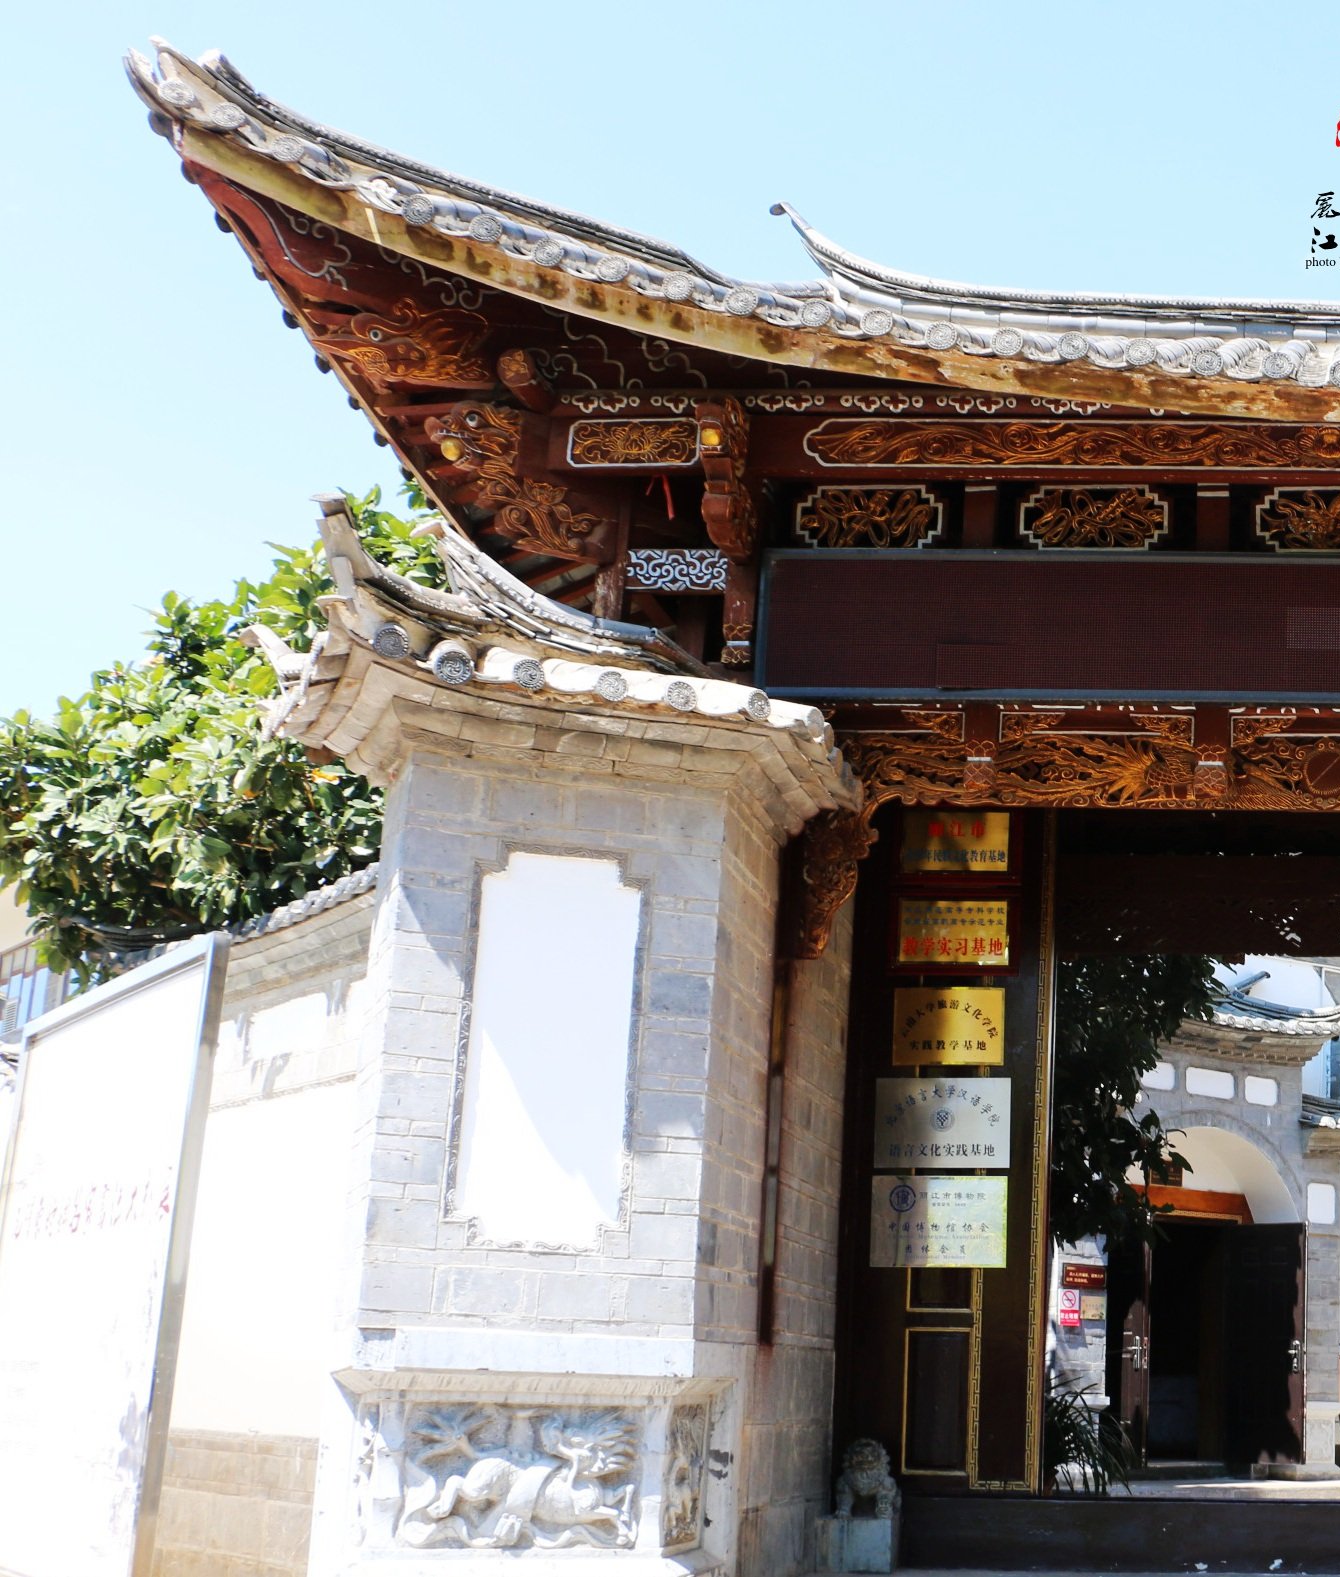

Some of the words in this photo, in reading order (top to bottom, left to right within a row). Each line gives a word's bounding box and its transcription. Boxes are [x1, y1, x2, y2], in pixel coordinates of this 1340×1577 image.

[903, 936, 1003, 956] 教学实习基地
[910, 1040, 987, 1051] 实践教学基地
[889, 1143, 996, 1158] 语言文化实践基地
[919, 1191, 987, 1201] 丽江市博物院
[889, 1222, 990, 1233] 中国博物馆协会
